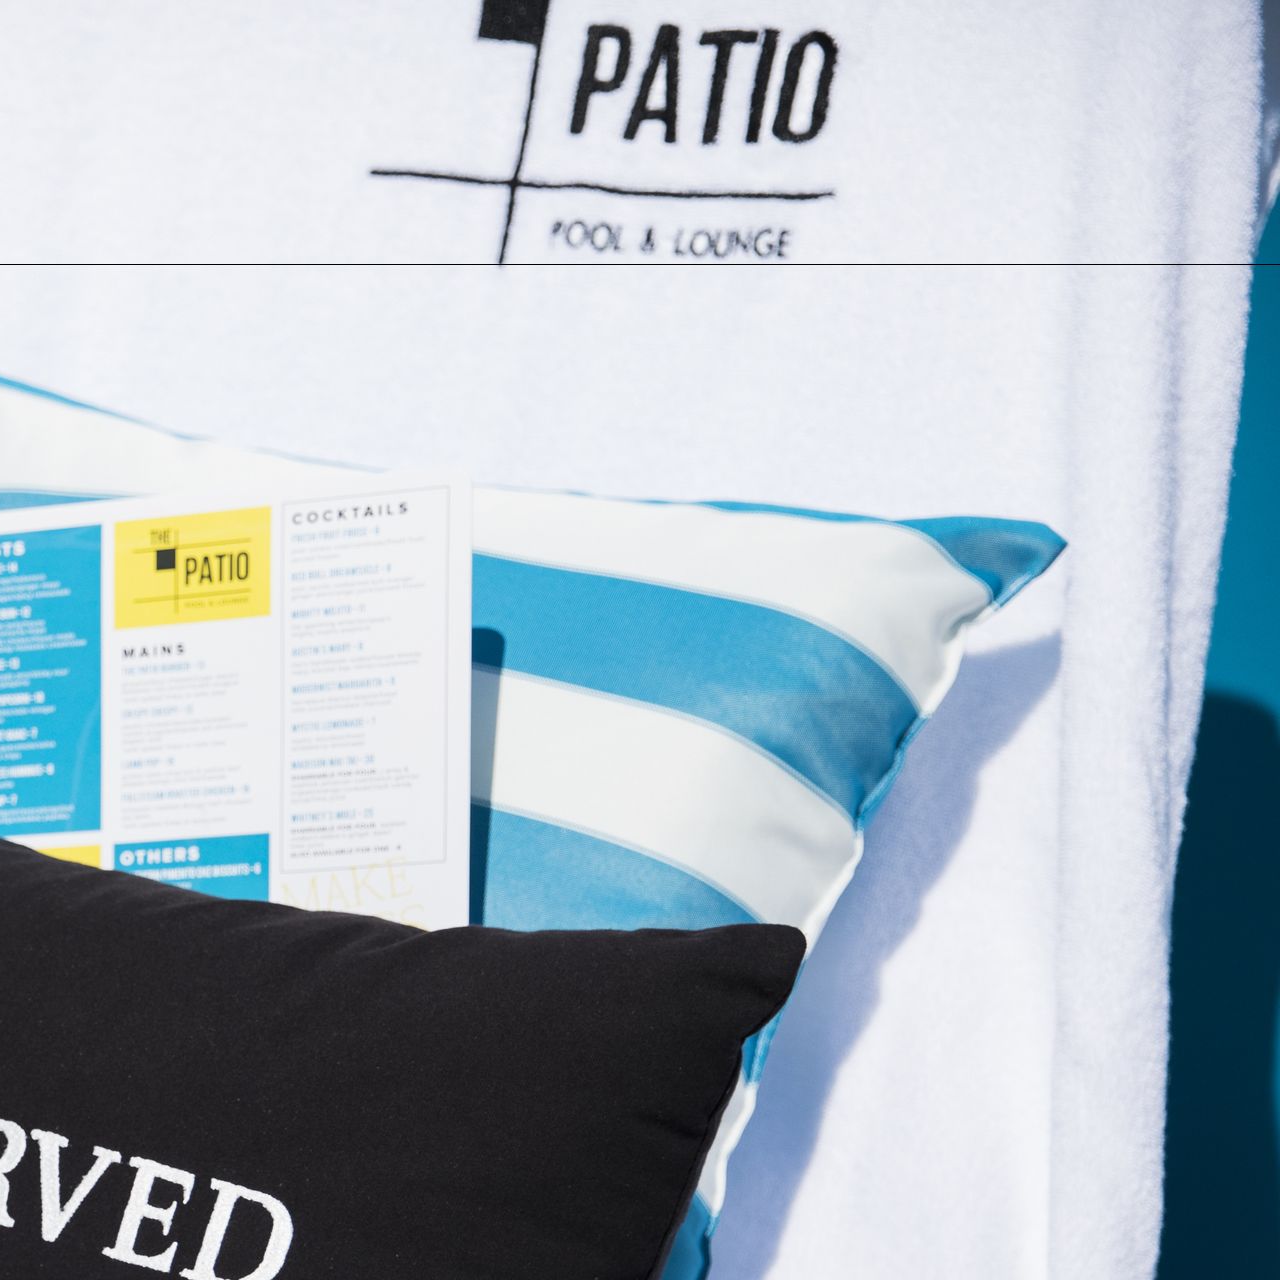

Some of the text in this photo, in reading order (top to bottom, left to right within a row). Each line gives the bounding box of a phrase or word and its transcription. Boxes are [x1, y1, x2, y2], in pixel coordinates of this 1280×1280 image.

[569, 23, 838, 144] PATIO
[551, 219, 624, 252] POOL
[674, 226, 792, 259] LOUNGE
[291, 502, 409, 525] COCKTAILS
[183, 551, 249, 586] PATIO
[122, 642, 186, 659] MAINS
[119, 845, 201, 867] OTHERS
